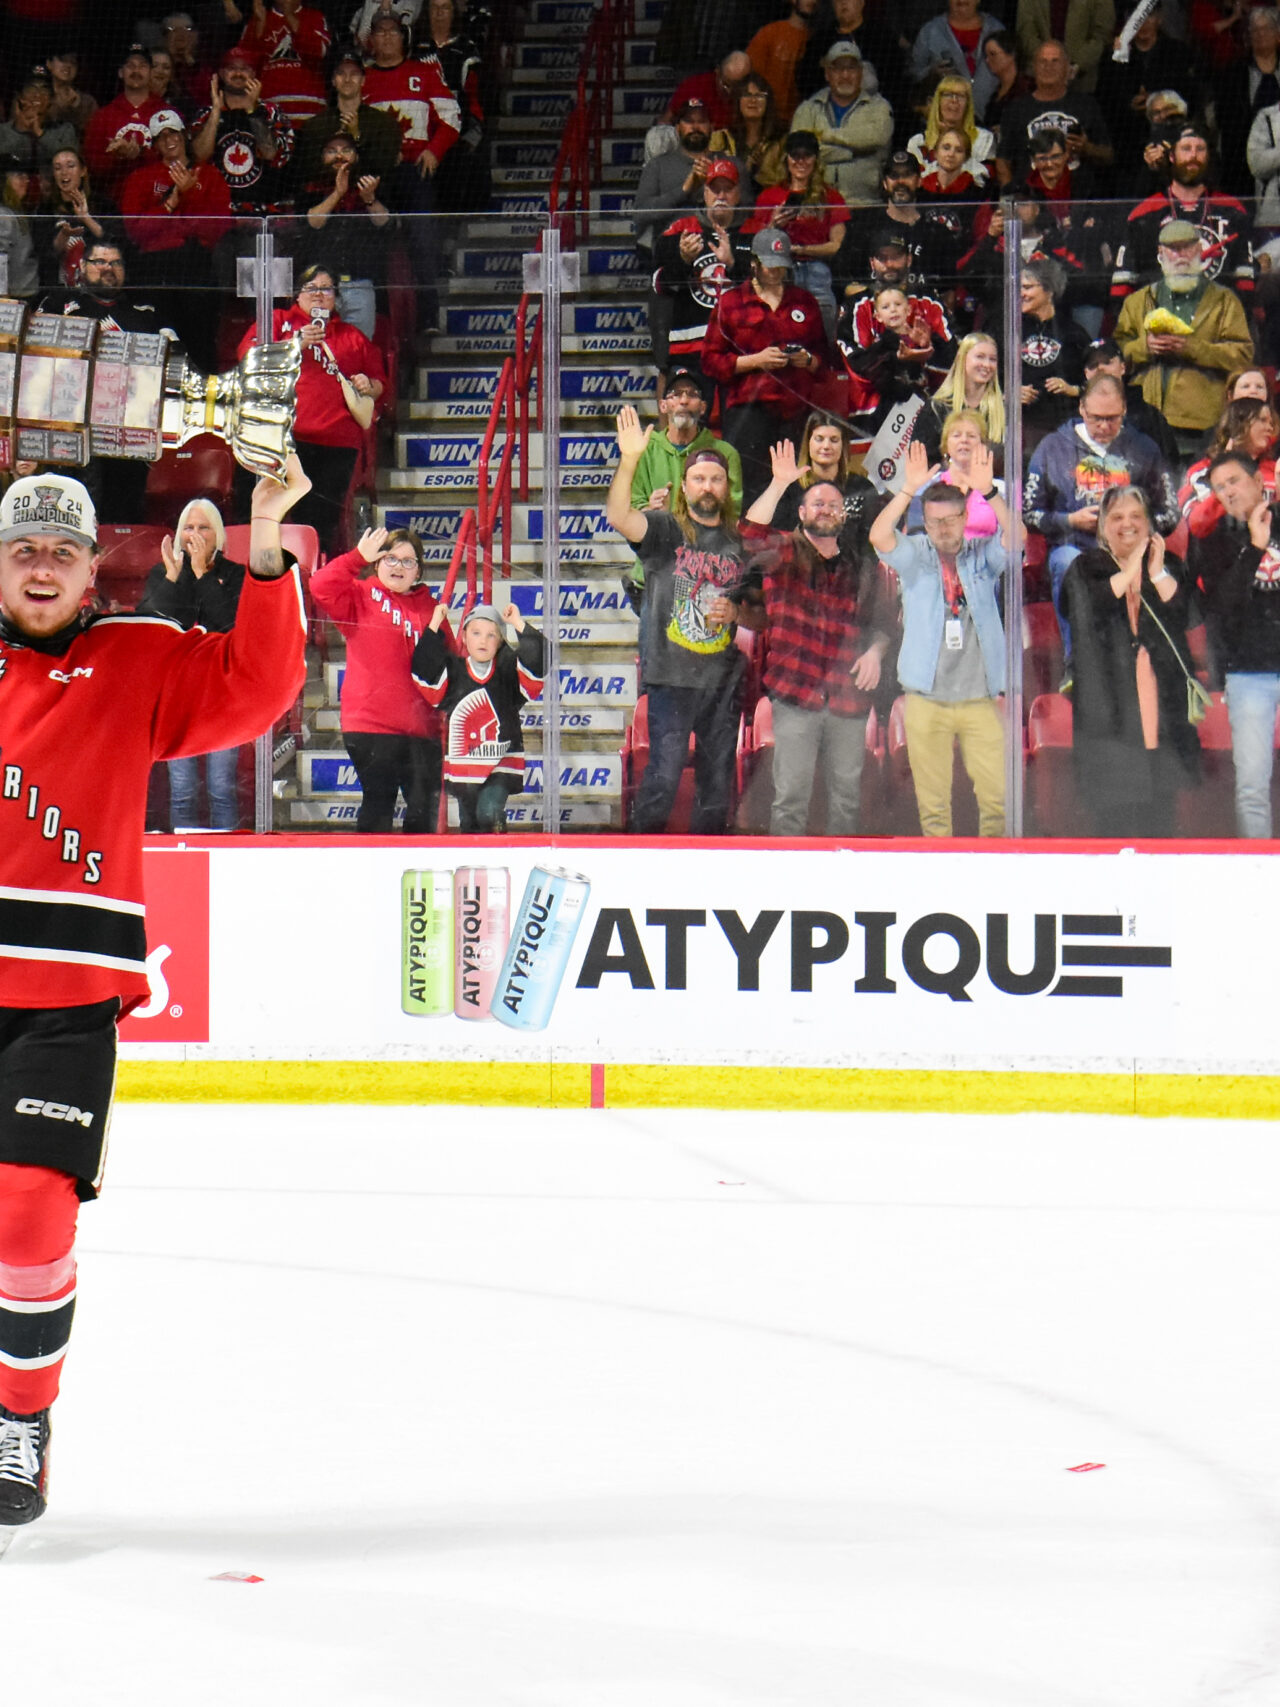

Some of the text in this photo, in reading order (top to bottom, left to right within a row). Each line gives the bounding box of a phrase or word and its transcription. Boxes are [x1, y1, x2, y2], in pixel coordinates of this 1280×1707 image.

[505, 170, 535, 180] FIRE
[582, 338, 652, 350] VANDALIS
[891, 413, 906, 434] GO
[13, 495, 83, 514] 20 24
[12, 508, 82, 529] CHAMPIONS
[410, 888, 428, 1004] ATYPIQUE
[463, 886, 482, 1007] ATYPIQUE
[502, 888, 555, 1015] ATYPIQUE
[575, 907, 1172, 1002] ATYPIQUE
[14, 1097, 95, 1129] CCM
